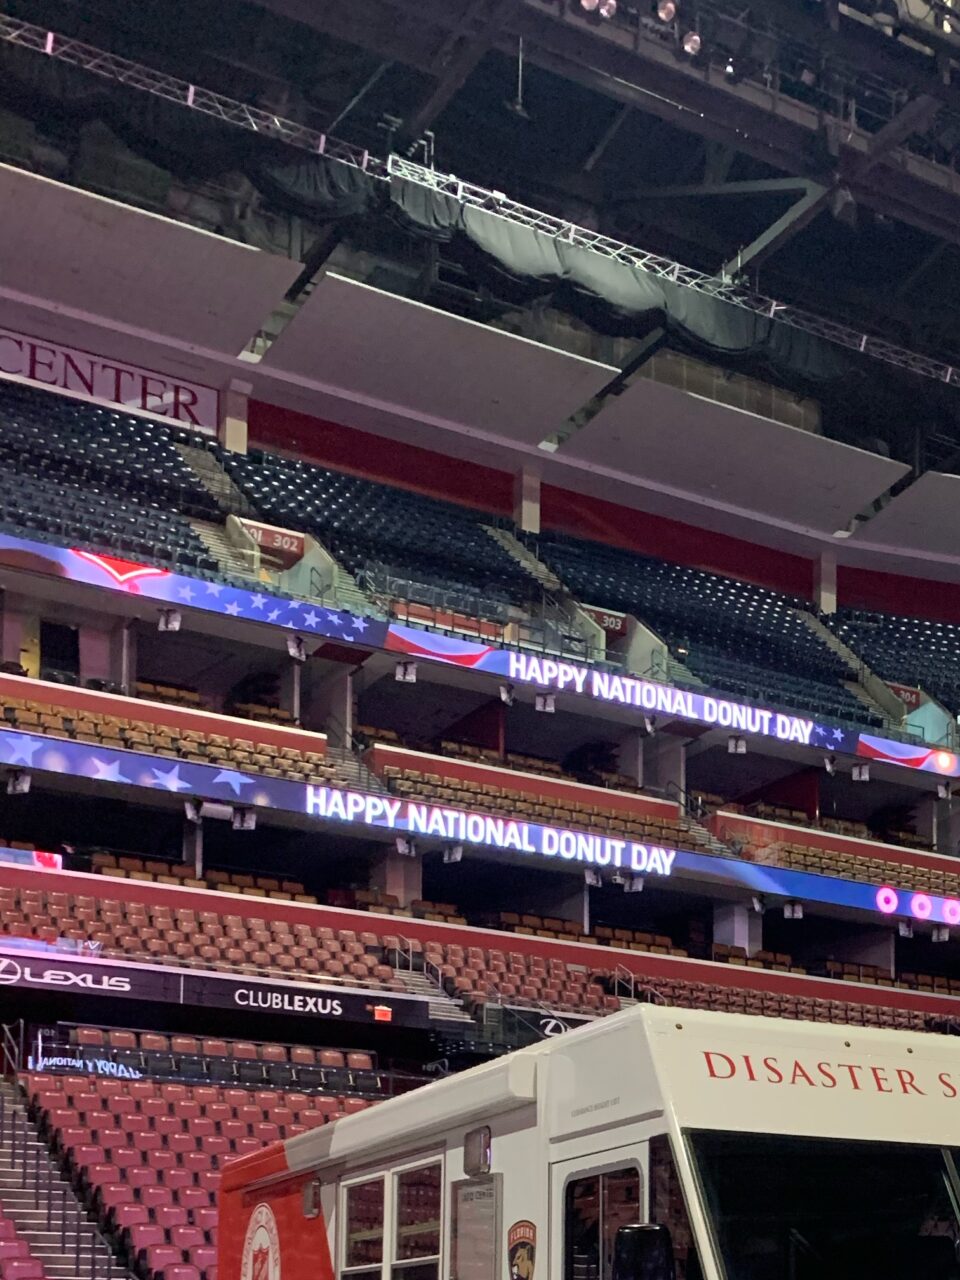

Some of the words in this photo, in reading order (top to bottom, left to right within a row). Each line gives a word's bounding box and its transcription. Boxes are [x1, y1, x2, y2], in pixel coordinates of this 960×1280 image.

[0, 334, 203, 427] CENTER
[272, 534, 298, 552] 302
[601, 615, 622, 630] 303
[509, 651, 588, 692] HAPPY
[592, 673, 698, 718] NATIONAL
[704, 699, 773, 734] DONUT
[777, 713, 813, 744] DAY
[306, 785, 400, 827] HAPPY
[408, 805, 536, 853] NATIONAL
[542, 832, 626, 867] DONUT
[631, 848, 676, 875] DAY
[23, 966, 131, 992] LEXUS
[234, 989, 343, 1017] CLUBLEXUS
[702, 1050, 929, 1096] DISASTER
